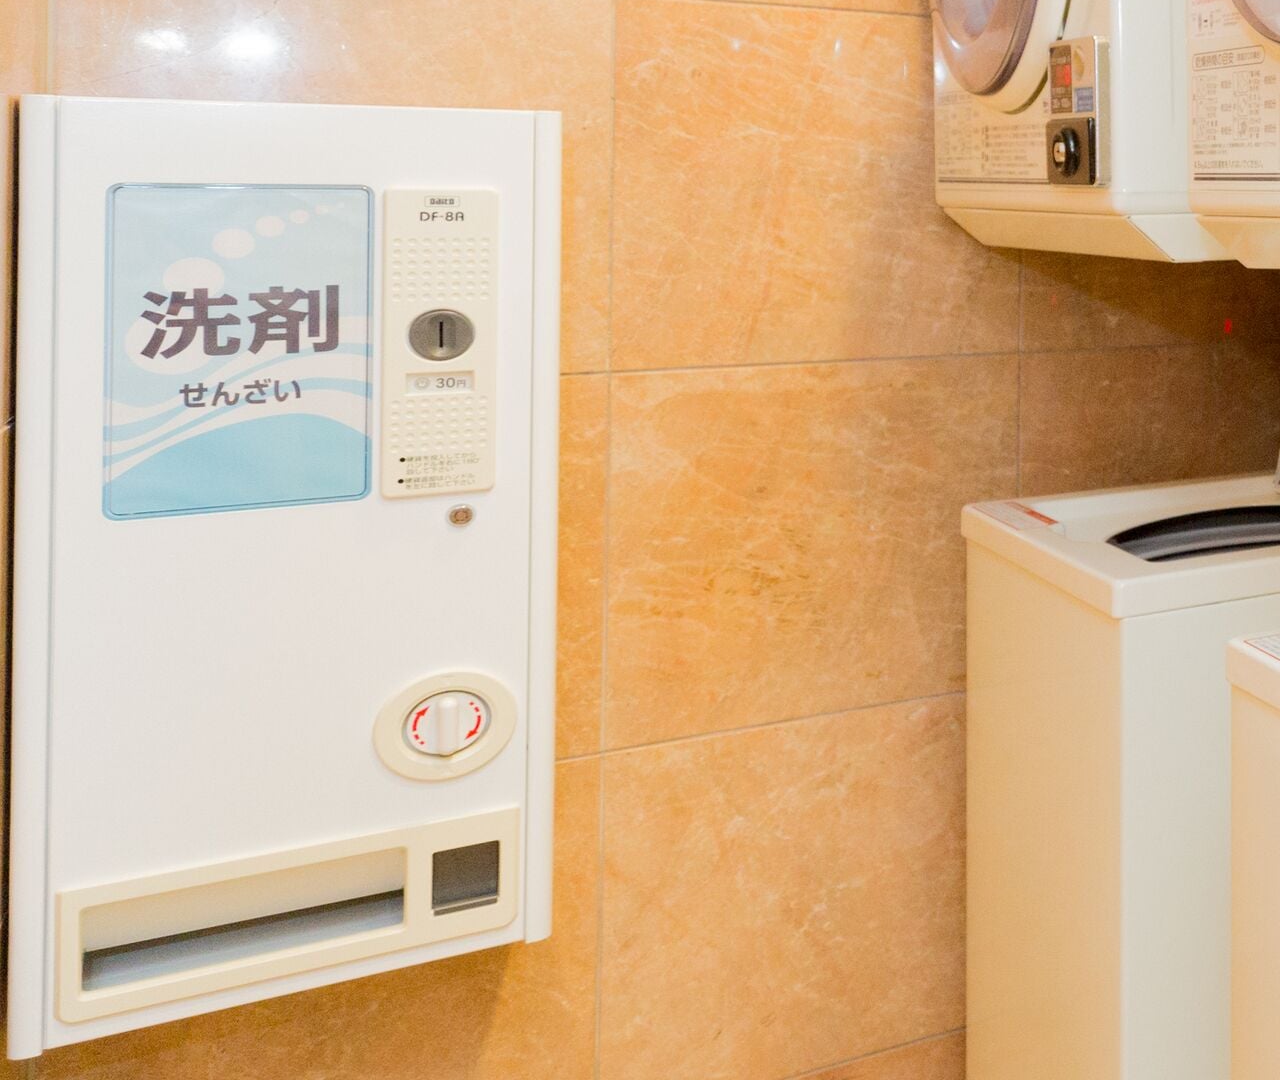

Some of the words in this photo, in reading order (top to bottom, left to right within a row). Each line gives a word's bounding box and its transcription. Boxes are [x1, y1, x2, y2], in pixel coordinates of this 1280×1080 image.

[420, 211, 465, 222] DF-8A
[140, 283, 342, 361] 洗剤
[177, 377, 303, 410] せんざい
